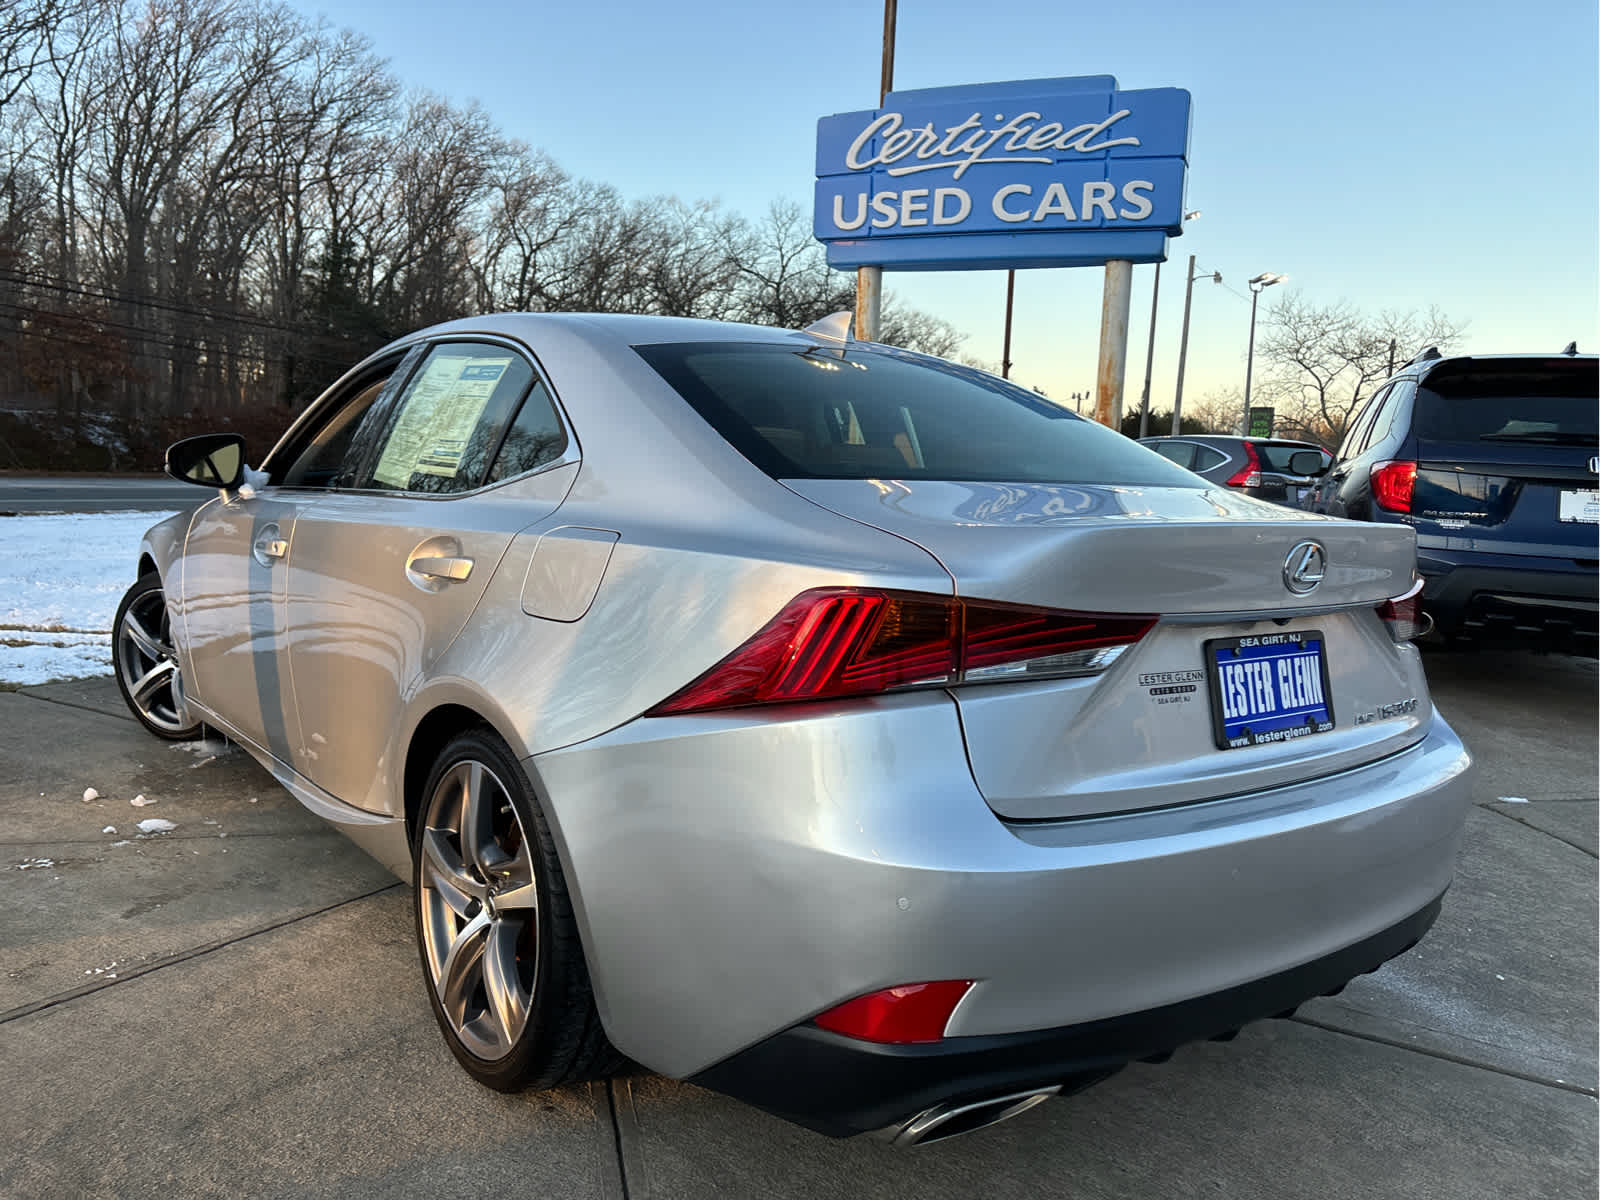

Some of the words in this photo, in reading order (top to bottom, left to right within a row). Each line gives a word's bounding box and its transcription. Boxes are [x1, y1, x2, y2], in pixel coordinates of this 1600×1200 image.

[845, 110, 1142, 180] Certified
[832, 186, 972, 231] USED
[991, 179, 1155, 222] CARS
[1239, 638, 1260, 648] SEA
[1289, 633, 1301, 643] NJ
[1138, 673, 1172, 685] LESTER
[1174, 671, 1204, 682] GLENN
[1217, 660, 1276, 719] LESTER
[1277, 655, 1324, 710] GLENN
